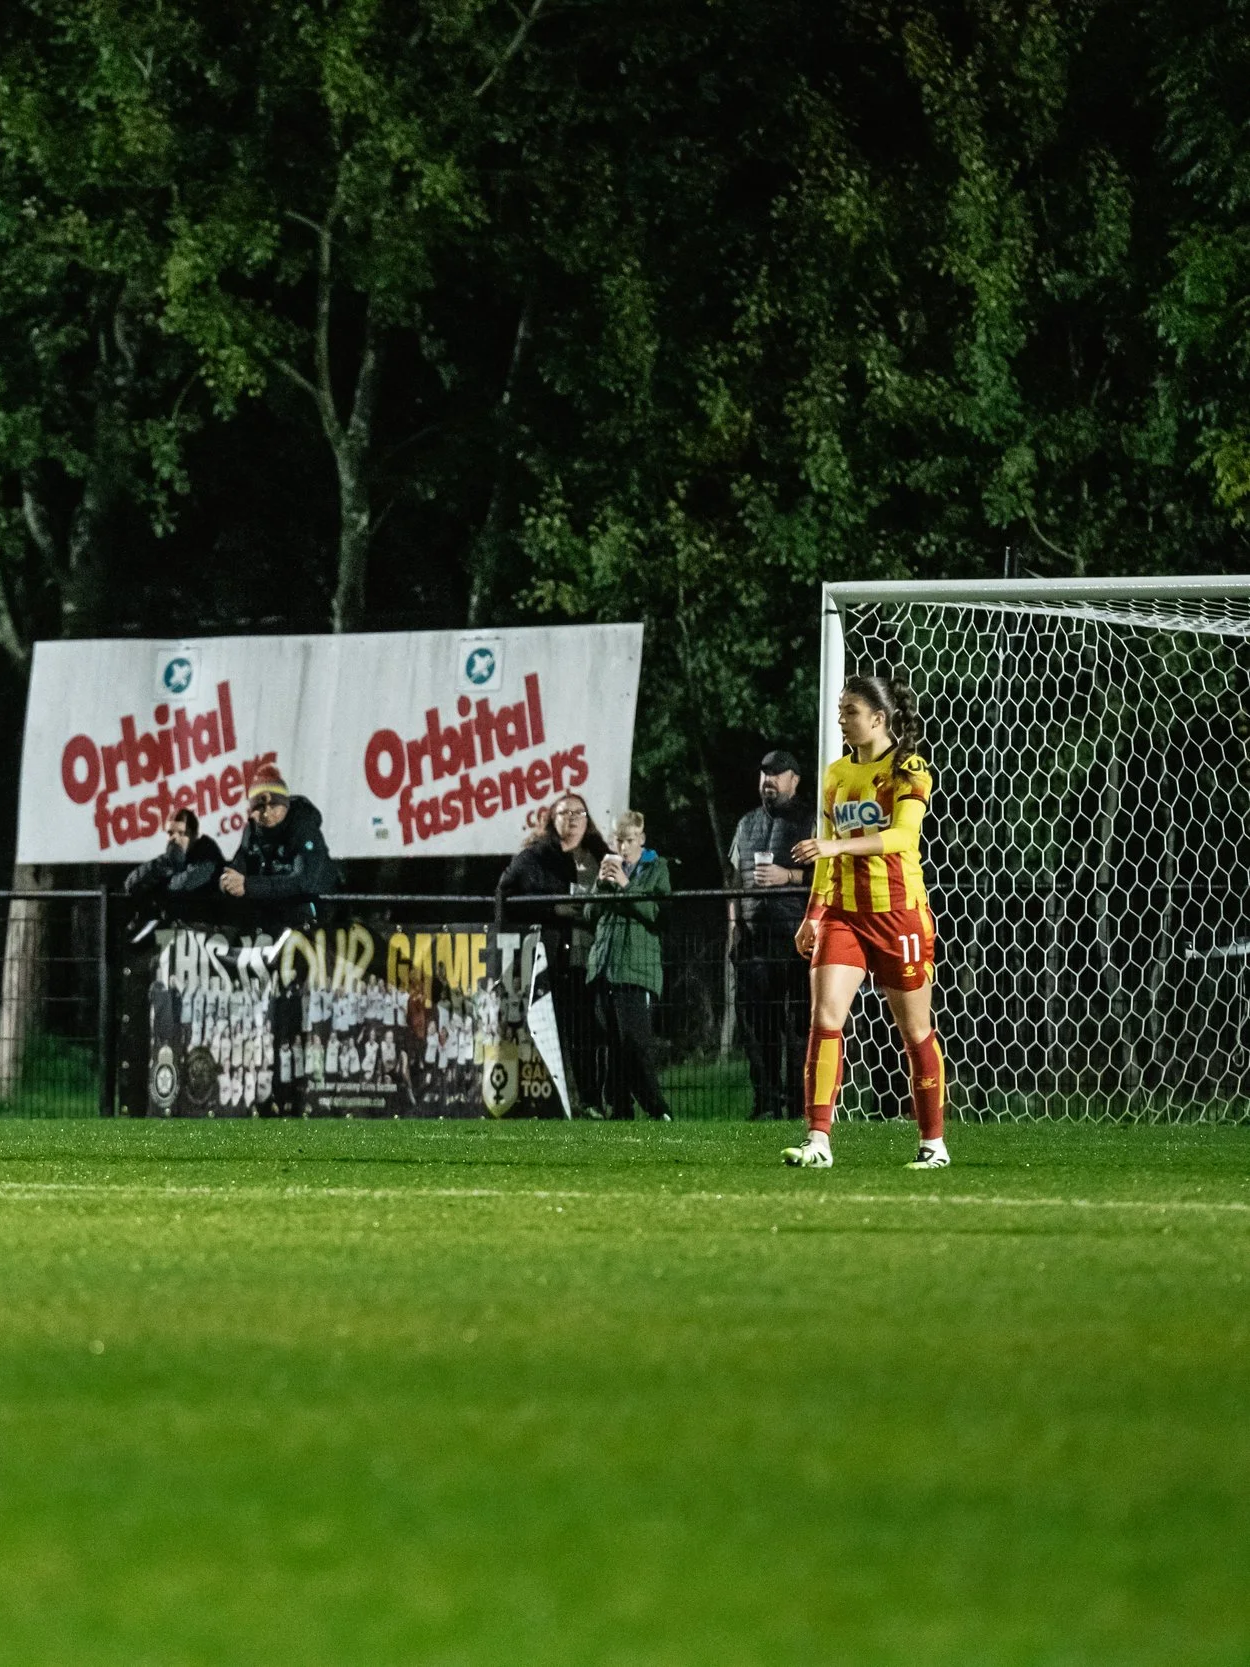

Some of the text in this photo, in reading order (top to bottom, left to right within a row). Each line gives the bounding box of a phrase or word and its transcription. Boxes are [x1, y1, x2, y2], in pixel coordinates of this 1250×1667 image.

[61, 680, 237, 805] Orbital
[365, 672, 546, 800] Orbital
[217, 811, 250, 837] .co
[398, 743, 589, 846] fasteners
[154, 928, 233, 998] THIS
[281, 923, 375, 993] OUR
[387, 932, 487, 1005] GAME
[898, 933, 920, 964] 11
[521, 1080, 552, 1098] TOO
